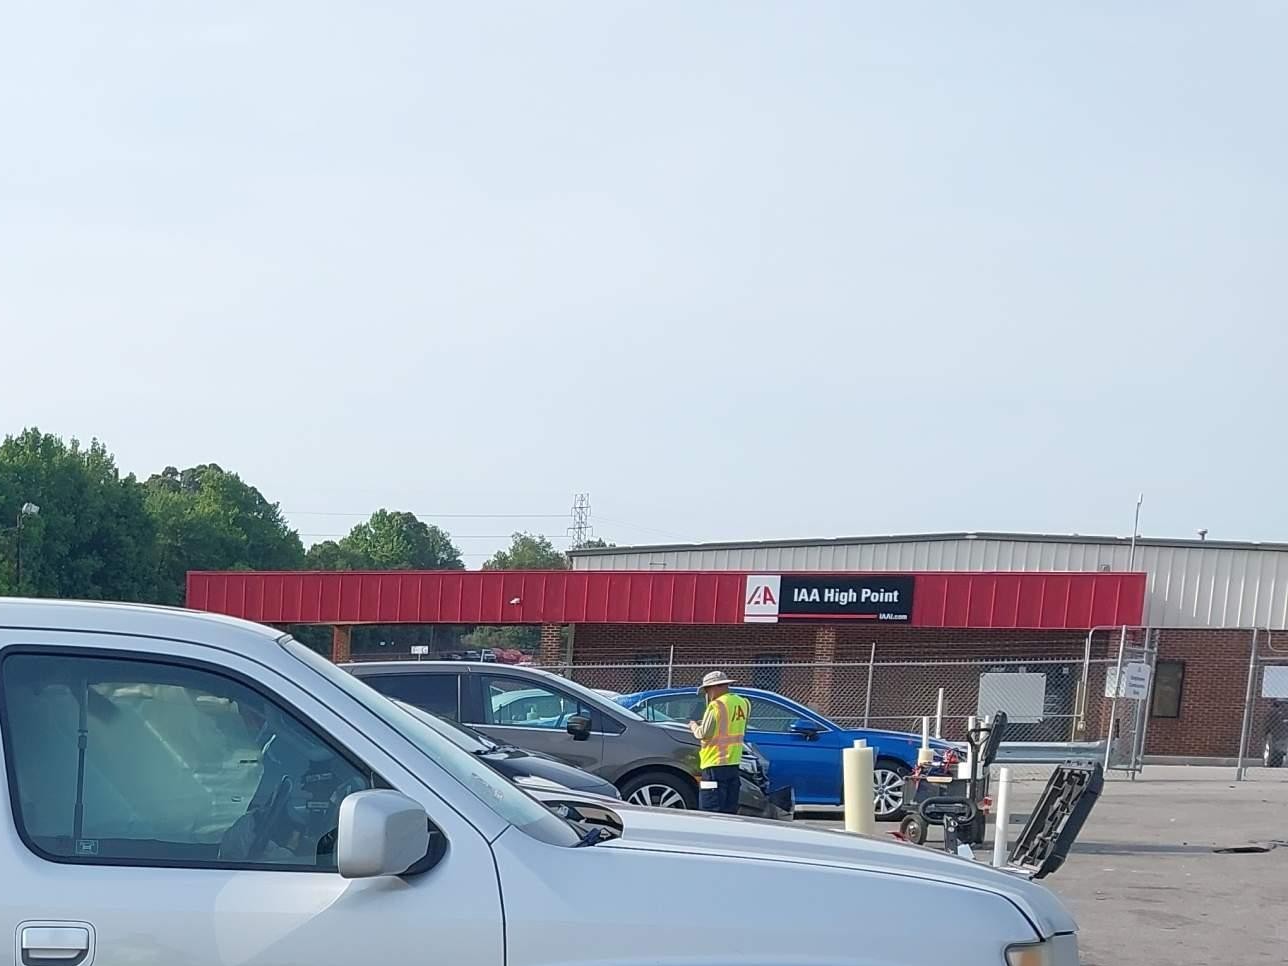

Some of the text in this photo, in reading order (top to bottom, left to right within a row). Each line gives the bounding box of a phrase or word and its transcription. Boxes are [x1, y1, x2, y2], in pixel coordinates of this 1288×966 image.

[793, 588, 899, 605] IAA High Point
